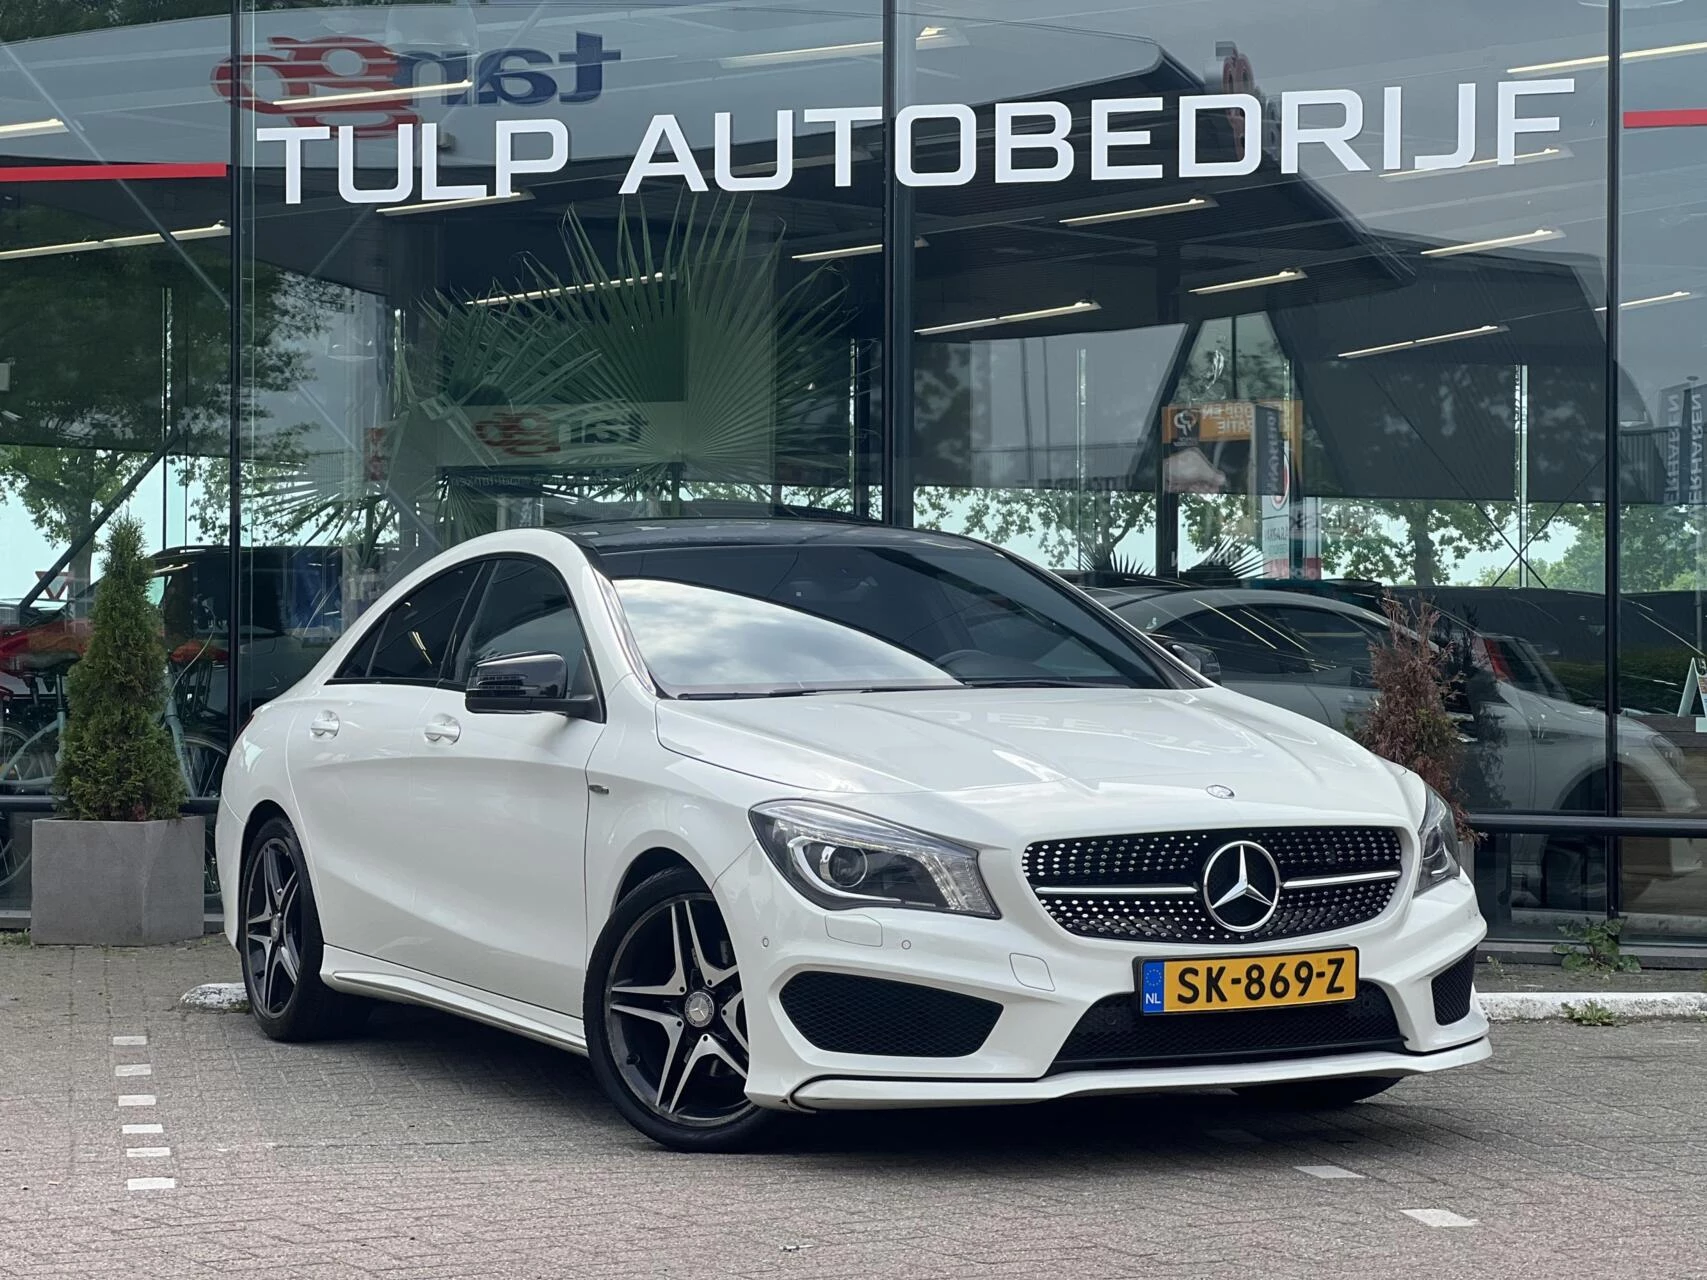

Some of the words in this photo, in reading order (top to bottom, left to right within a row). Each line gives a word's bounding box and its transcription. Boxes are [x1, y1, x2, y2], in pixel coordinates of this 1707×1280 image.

[256, 118, 569, 204] TULP
[618, 78, 1576, 195] AUTOBEDRIJF
[1145, 993, 1161, 1004] NL
[1177, 958, 1345, 1004] SK-869-Z
